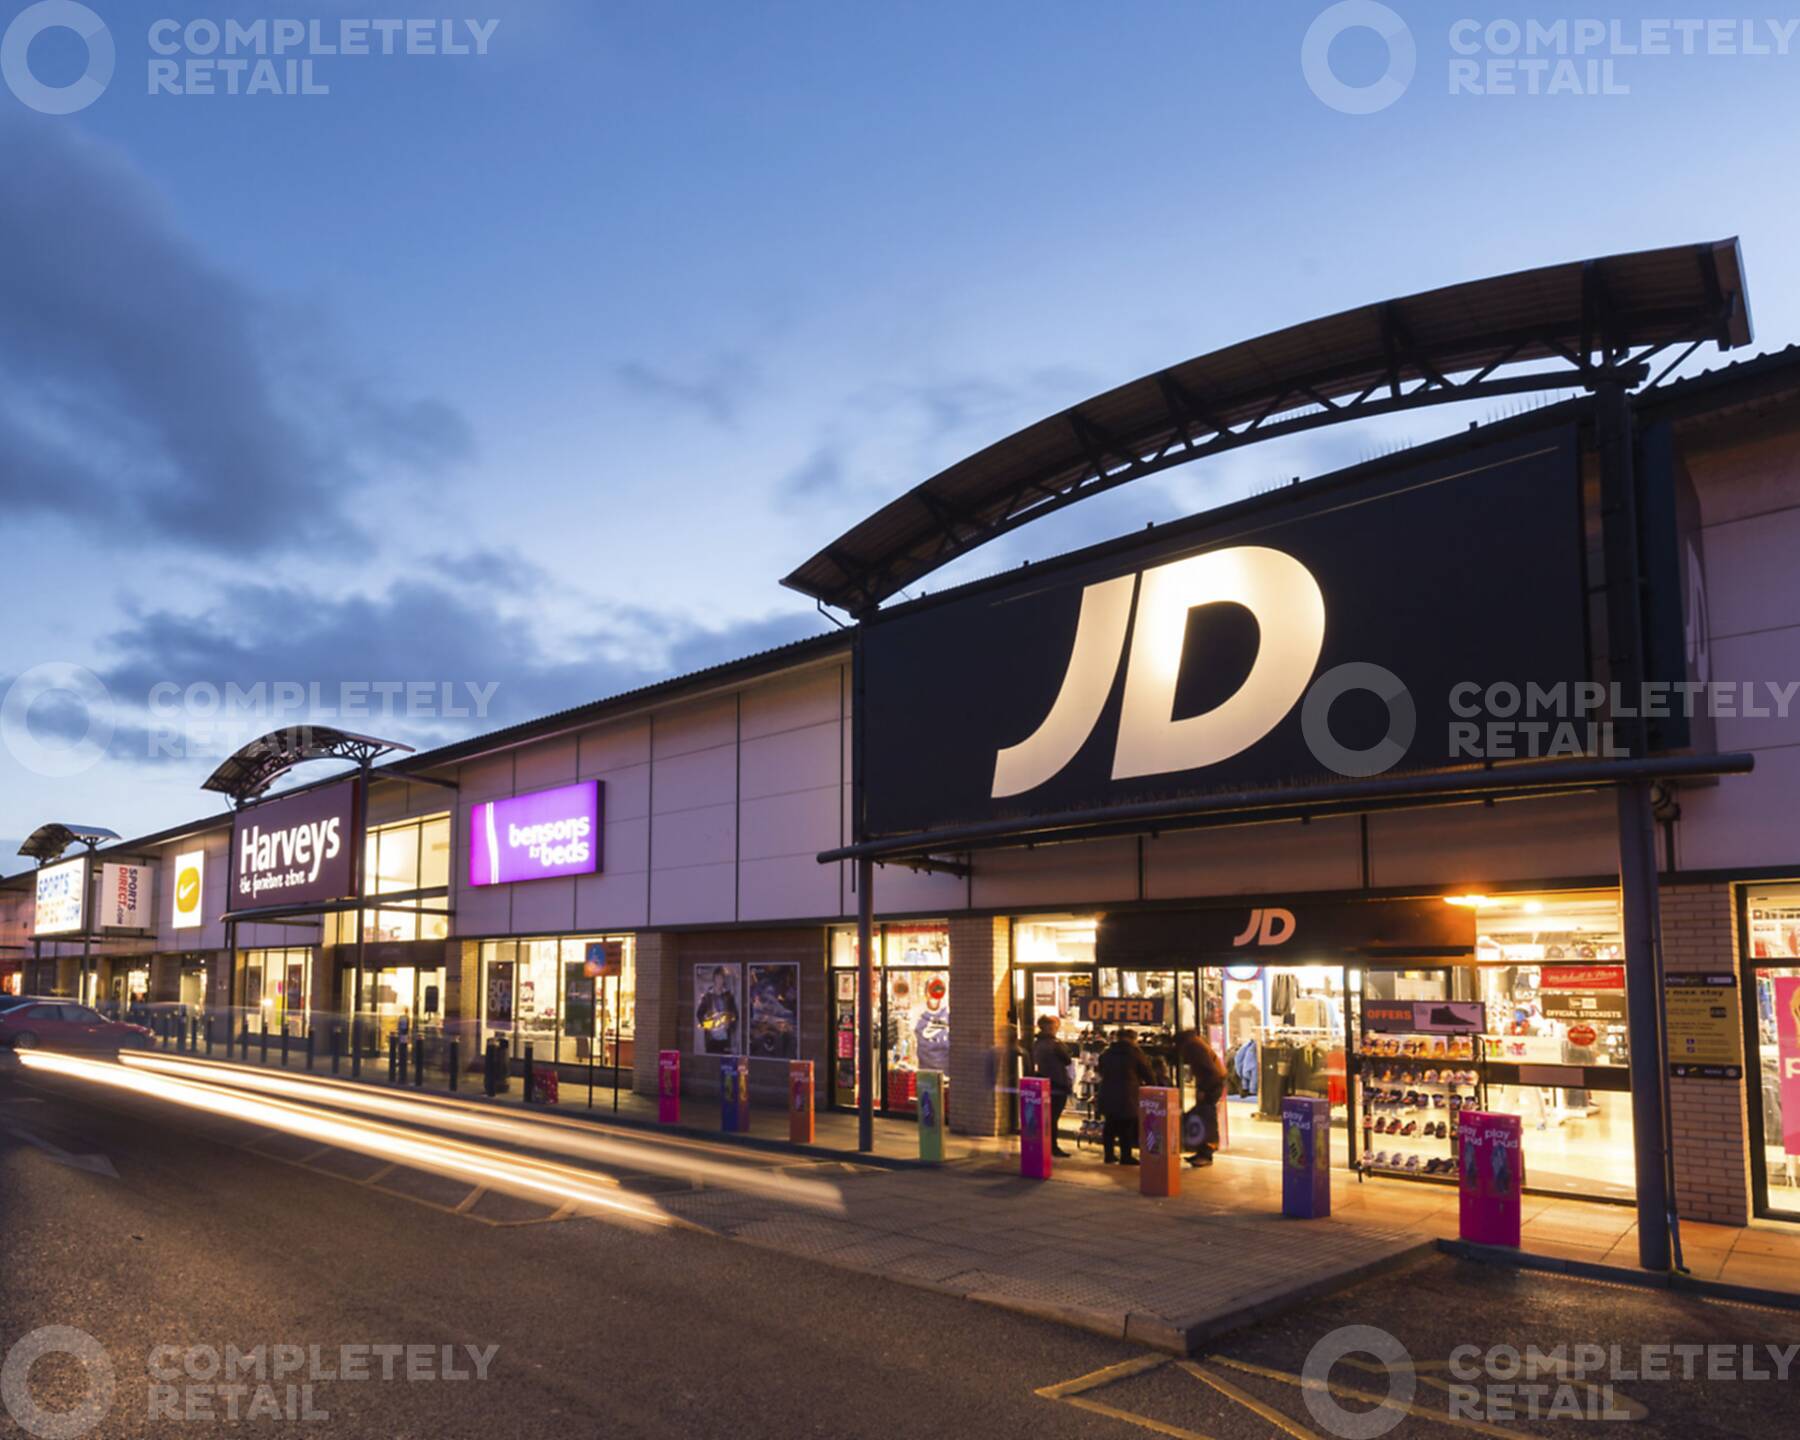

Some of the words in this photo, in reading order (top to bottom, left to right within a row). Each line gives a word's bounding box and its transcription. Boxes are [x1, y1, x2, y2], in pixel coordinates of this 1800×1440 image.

[991, 546, 1326, 799] JD
[508, 816, 590, 848] bensons
[240, 817, 340, 883] Harveys
[541, 841, 589, 867] beds
[126, 867, 138, 911] SPORTS
[1233, 908, 1297, 947] JD
[1088, 999, 1154, 1022] OFFER
[1367, 1009, 1413, 1021] OFFERS
[1545, 1009, 1578, 1018] OFFICIAL
[1485, 1127, 1511, 1140] play
[1492, 1137, 1518, 1148] loud
